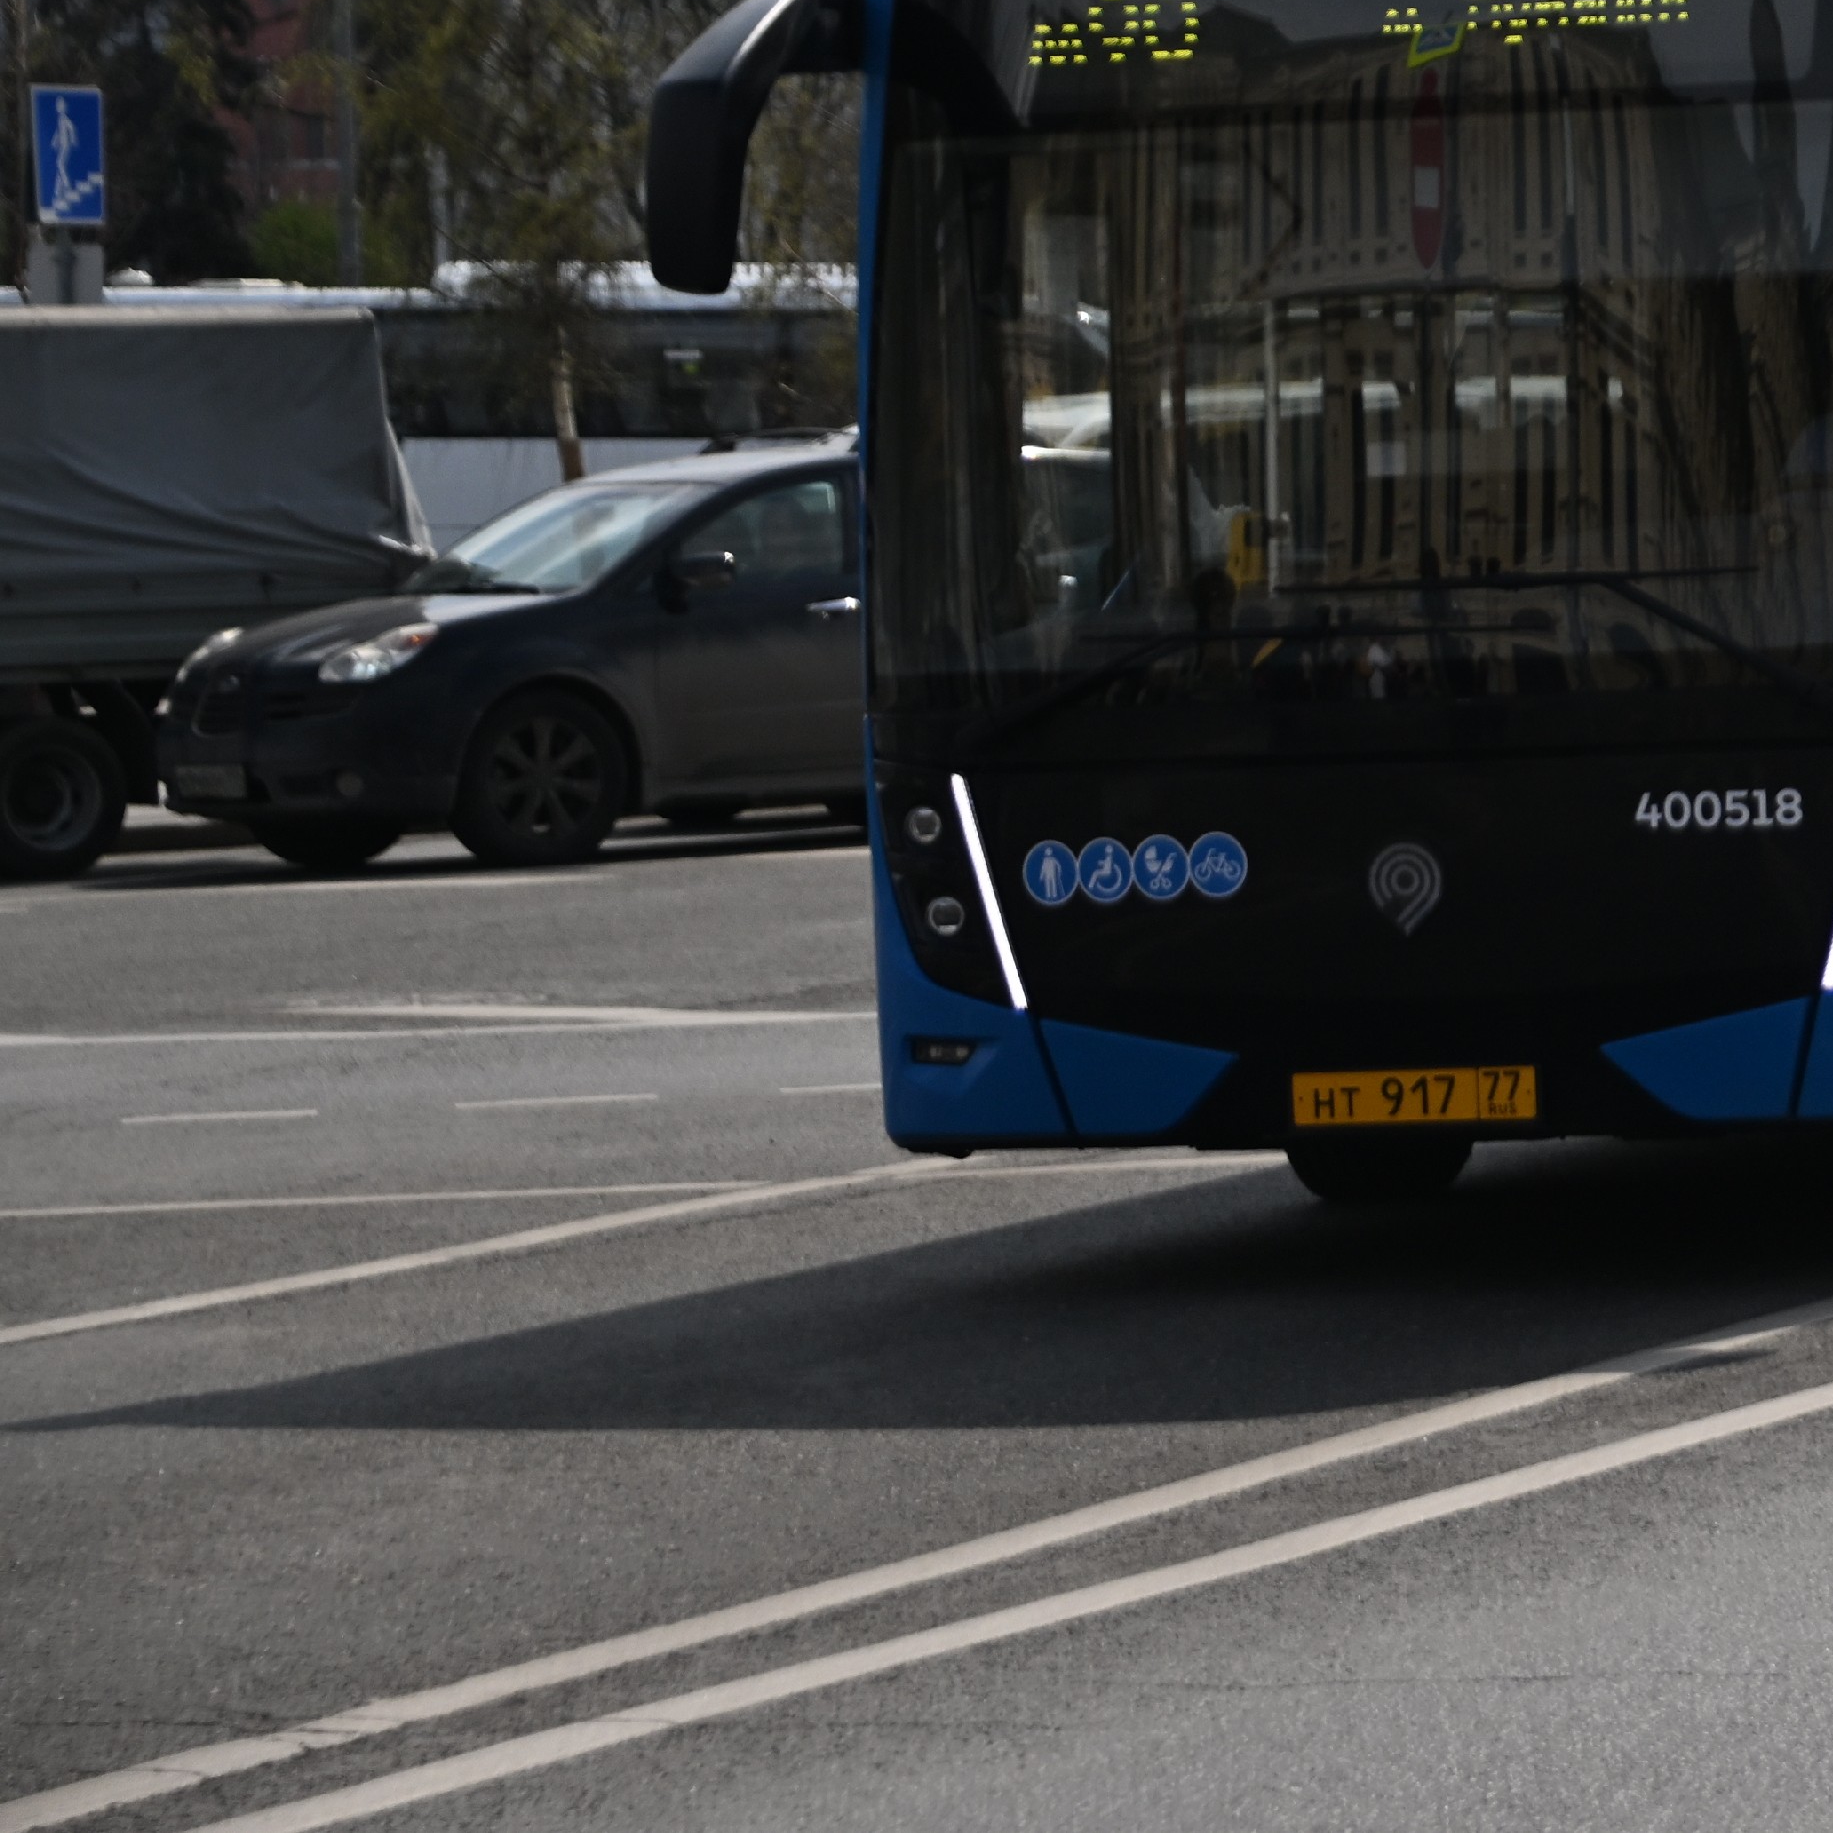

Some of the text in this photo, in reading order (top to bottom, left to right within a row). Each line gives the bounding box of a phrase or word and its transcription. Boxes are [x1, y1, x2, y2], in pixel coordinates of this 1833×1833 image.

[1635, 787, 1804, 829] 400518
[1381, 1073, 1457, 1117] 917
[1482, 1069, 1522, 1103] 77
[1487, 1101, 1519, 1116] RUS
